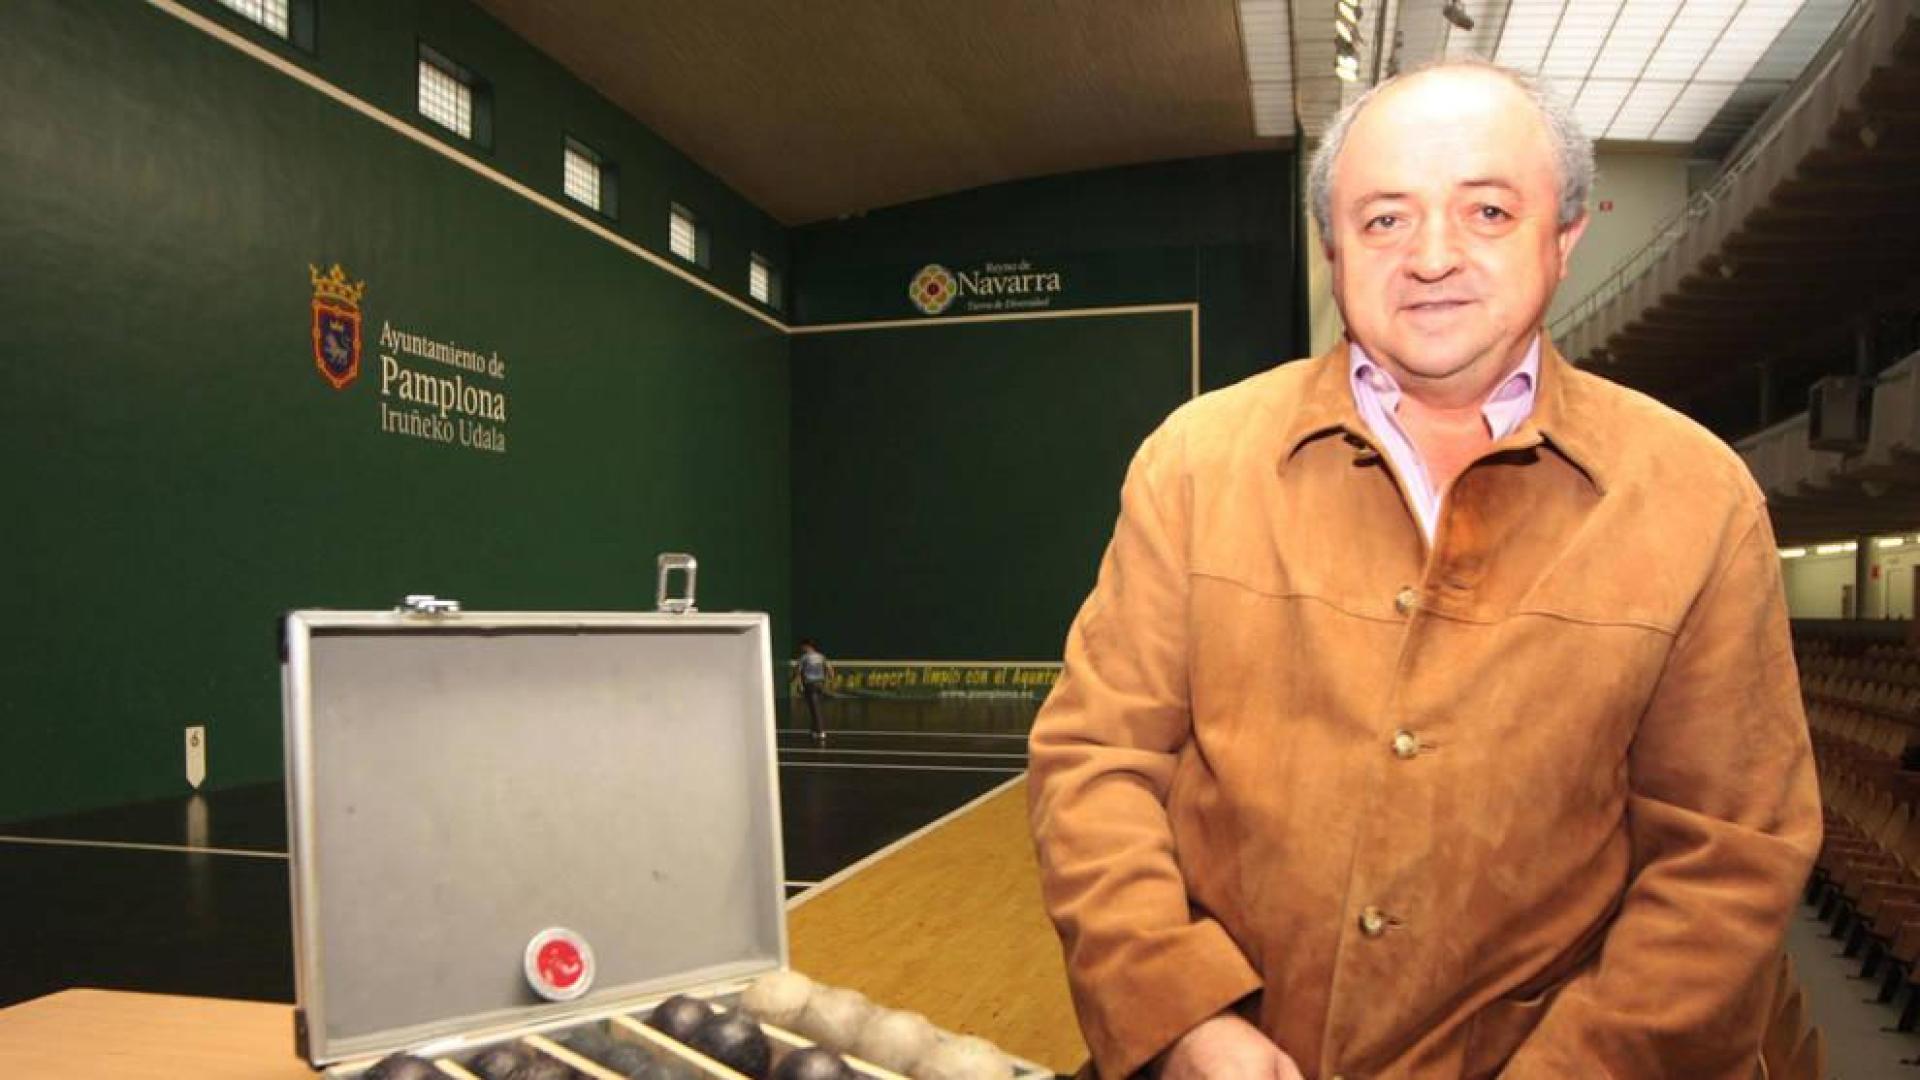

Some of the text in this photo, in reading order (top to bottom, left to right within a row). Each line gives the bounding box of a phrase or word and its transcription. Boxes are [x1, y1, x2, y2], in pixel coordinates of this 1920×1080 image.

[958, 271, 1062, 296] Navarra
[379, 320, 505, 379] Ayuntamiento de
[380, 355, 505, 421] Pamplona
[381, 402, 506, 453] Iruñeko Udala
[965, 670, 987, 682] con
